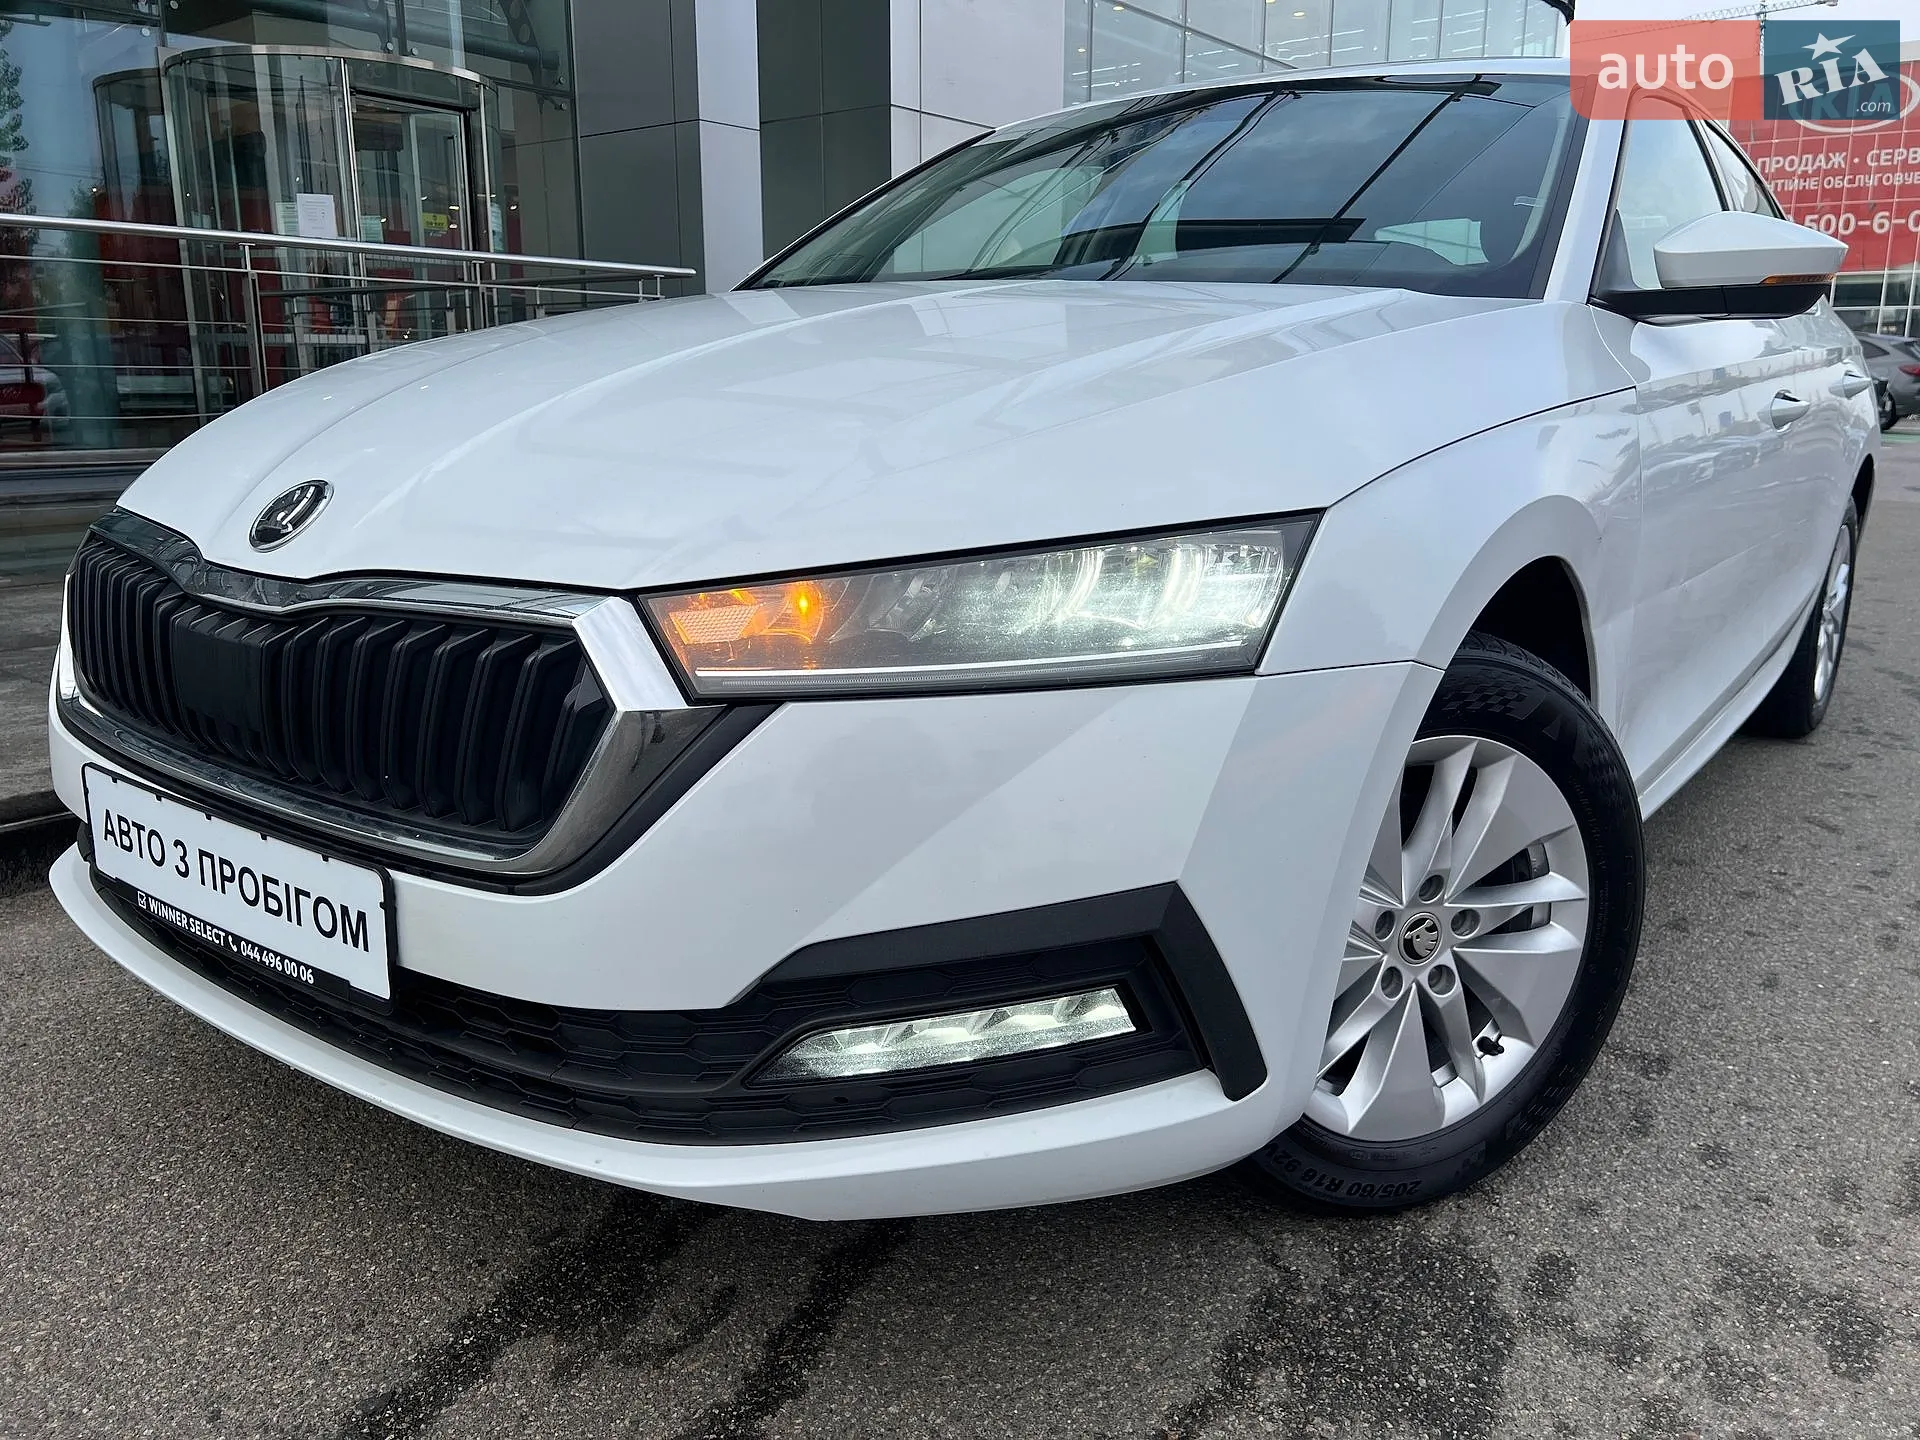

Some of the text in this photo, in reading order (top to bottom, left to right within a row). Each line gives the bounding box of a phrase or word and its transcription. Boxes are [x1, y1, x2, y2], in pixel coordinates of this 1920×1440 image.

[1757, 151, 1847, 175] ПРОДАЖ
[103, 808, 166, 868] АВТО
[197, 847, 371, 953] ПРОБІГОМ
[148, 897, 315, 985] WINNER SELECT 044 496 00 06
